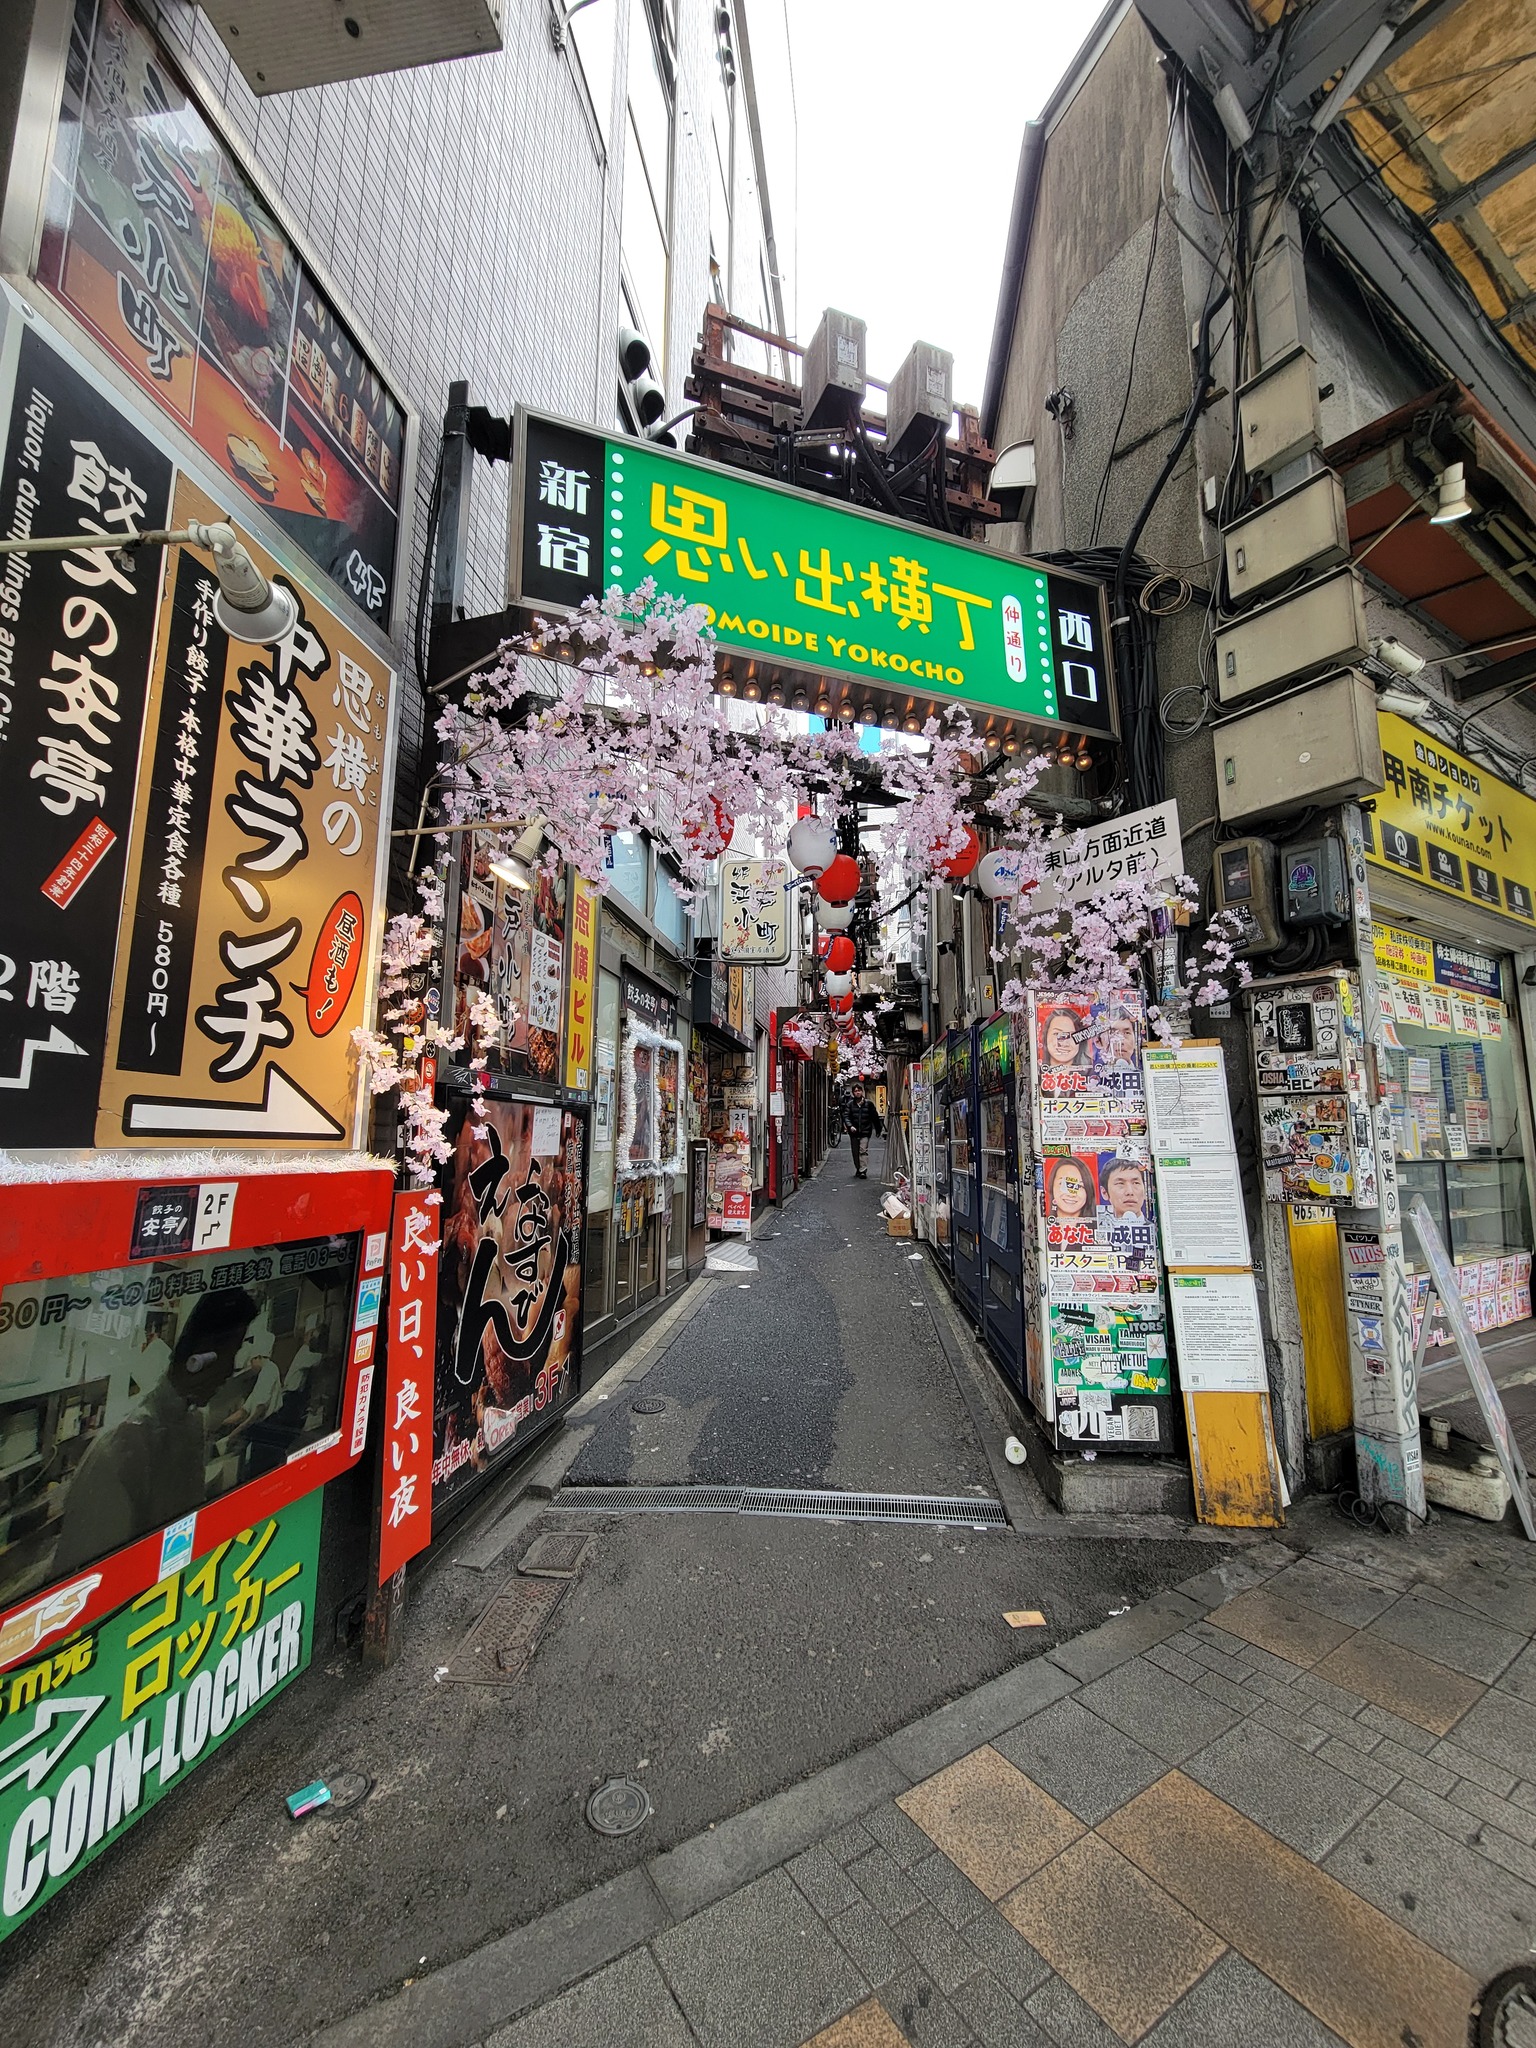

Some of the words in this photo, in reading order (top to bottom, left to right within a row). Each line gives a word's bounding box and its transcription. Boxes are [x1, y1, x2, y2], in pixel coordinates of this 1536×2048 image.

[24, 387, 53, 474] liquor,
[538, 460, 590, 578] 新宿
[643, 482, 993, 651] 思い出横丁
[30, 438, 148, 816] 餃子の安亭
[826, 635, 966, 686] YOKOCHO
[1004, 604, 1023, 675] 仲通り
[1058, 609, 1098, 704] 西口
[156, 578, 214, 909] 手作り餃子・本格中華定食各種
[321, 650, 376, 857] 思横の
[1415, 743, 1481, 794] 金券ショップ
[202, 590, 330, 1074] 中華ランチ
[1383, 749, 1513, 853] 甲南チケット
[49, 823, 109, 898] 昭和三十四年創業
[1425, 820, 1492, 860] www.kounan.com
[571, 892, 591, 1064] 思横ビル
[1041, 1072, 1087, 1091] あなた
[141, 1216, 181, 1237] 安亭
[152, 1204, 182, 1215] 餃子の
[203, 1194, 229, 1215] 2F
[1048, 1224, 1094, 1244] あなた
[1110, 1226, 1152, 1244] 成田
[366, 1257, 383, 1266] PayPay
[398, 1205, 427, 1360] 良い日、
[1085, 1334, 1110, 1344] VISAH
[353, 1373, 371, 1449] 防犯カメラ設置
[534, 1361, 560, 1412] 3F
[386, 1378, 422, 1530] 良い夜
[1107, 1416, 1115, 1438] VEGAN
[121, 1561, 302, 1722] ロッカー
[2, 1600, 303, 1918] COIN-LOCKER
